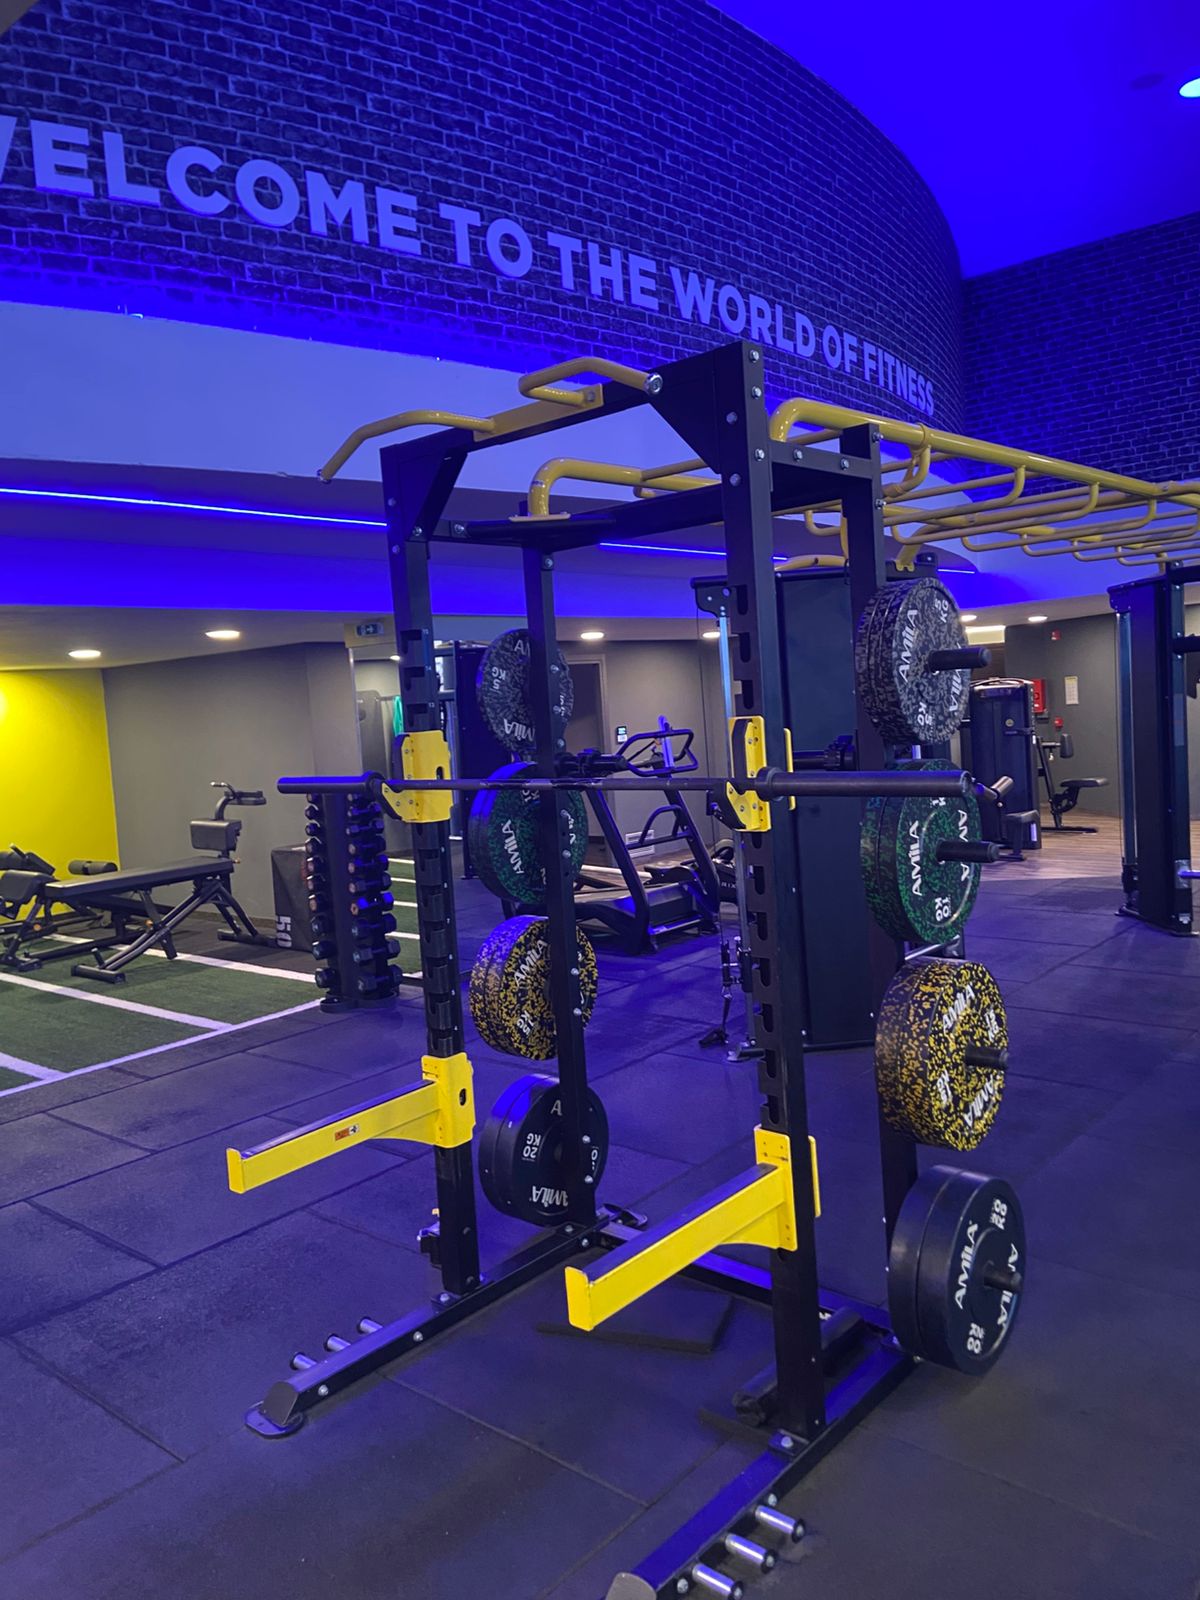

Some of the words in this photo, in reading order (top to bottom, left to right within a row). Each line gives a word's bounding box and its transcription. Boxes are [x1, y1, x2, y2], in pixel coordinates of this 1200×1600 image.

[0, 115, 422, 256] ELCOME
[438, 203, 533, 278] TO
[547, 231, 659, 310] THE
[669, 265, 815, 357] WORLD
[821, 325, 859, 373] OF
[863, 341, 935, 416] FITNESS
[503, 718, 536, 741] MILA
[526, 1133, 542, 1146] KG
[522, 1146, 538, 1158] 20
